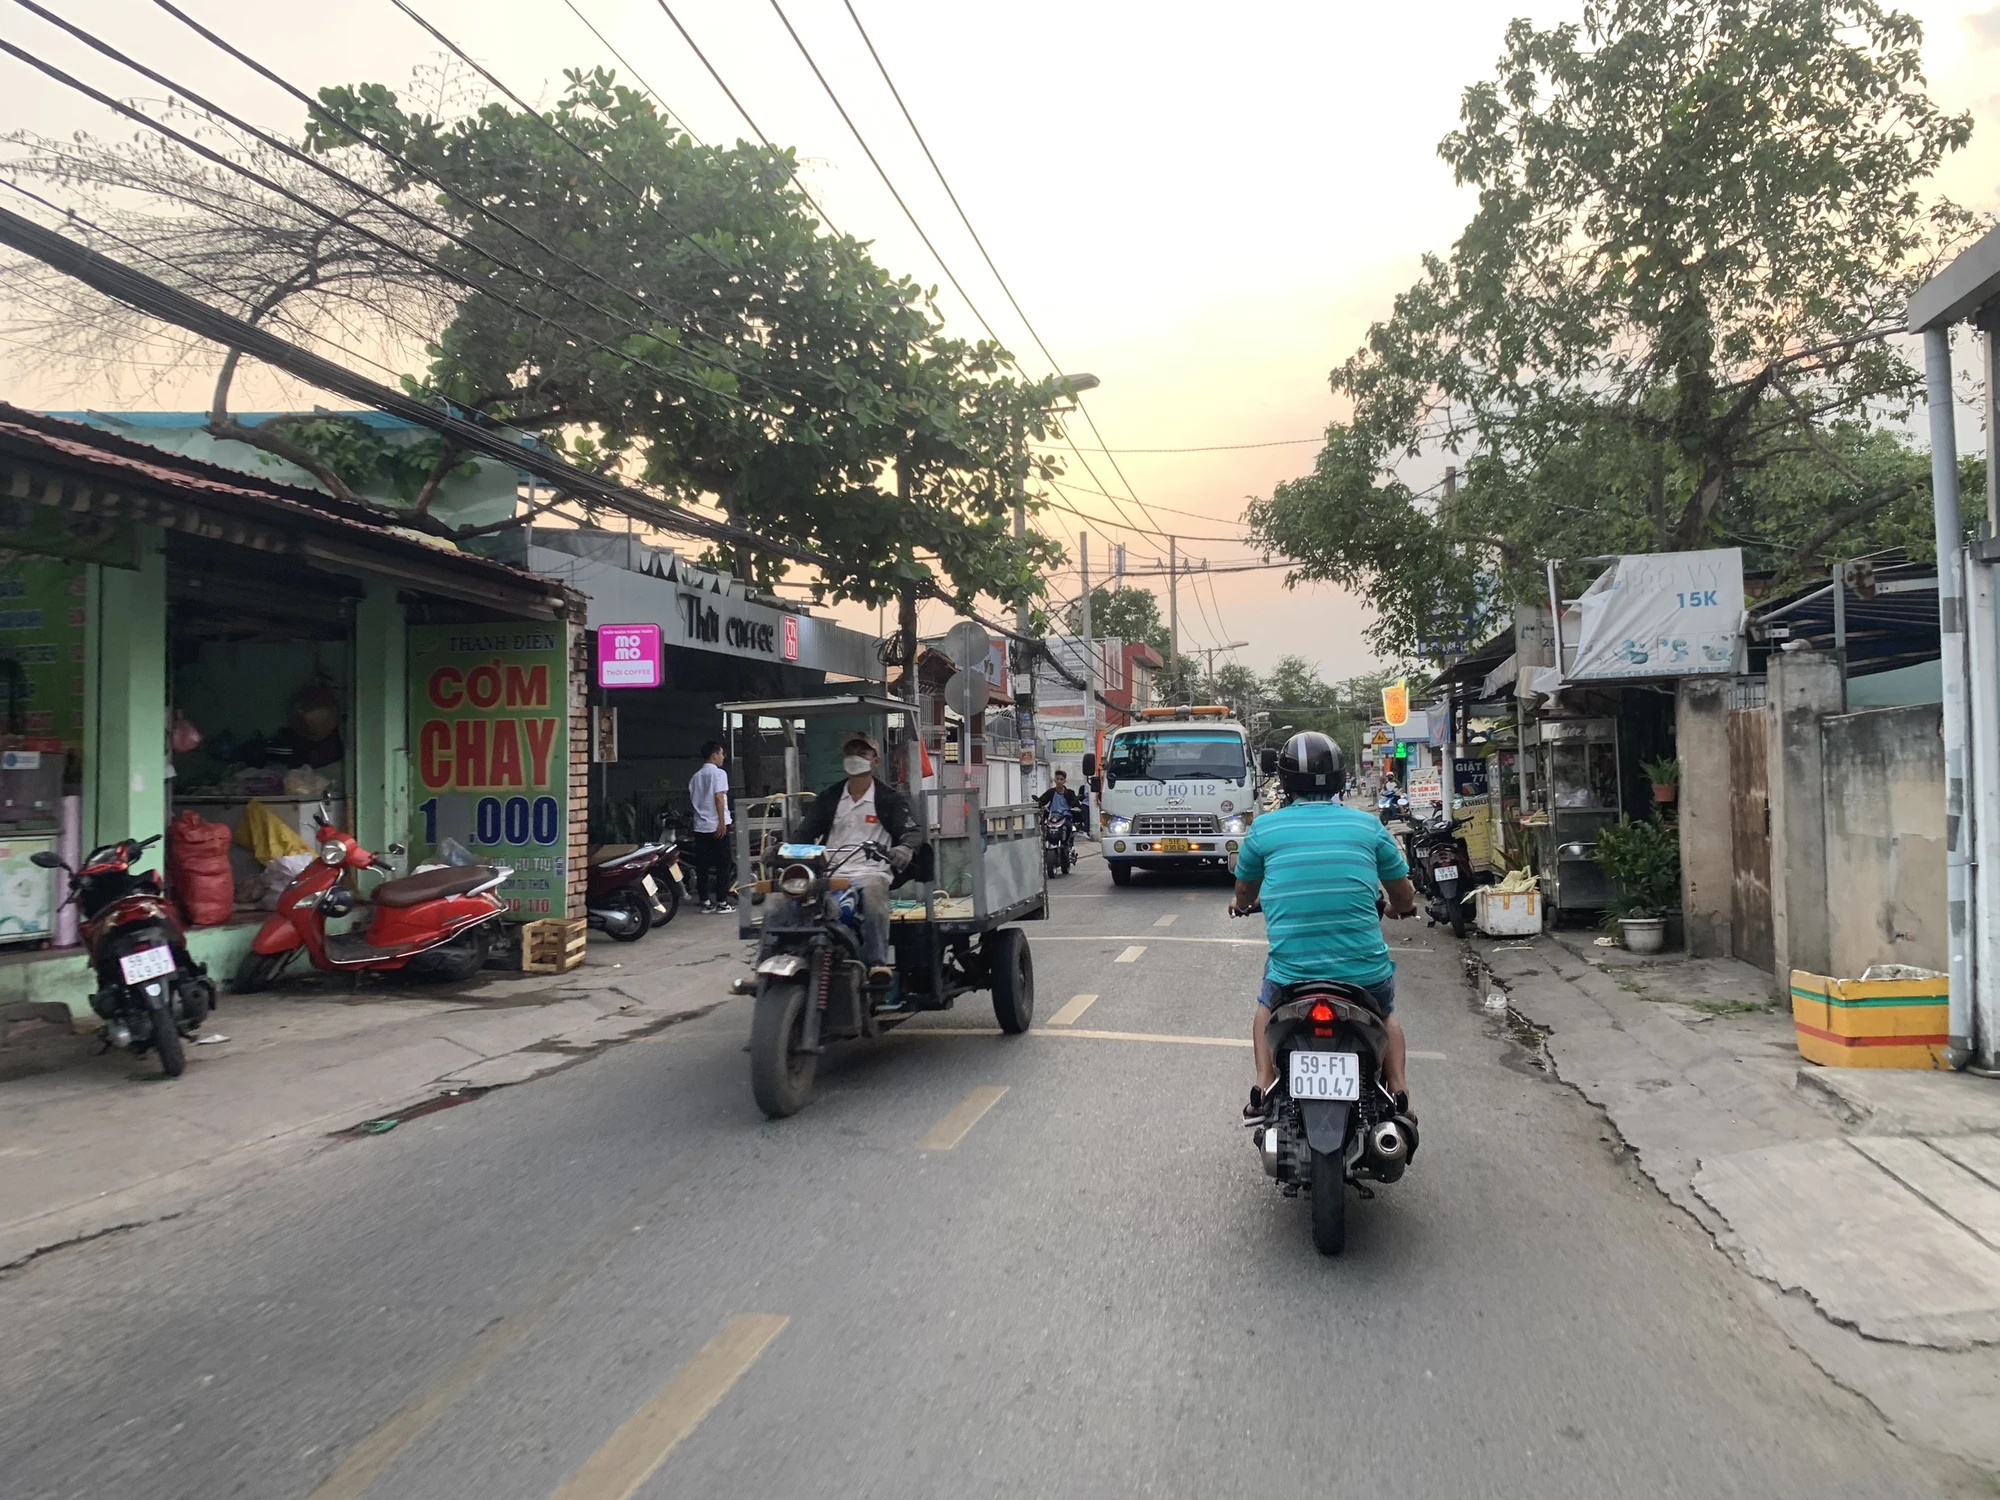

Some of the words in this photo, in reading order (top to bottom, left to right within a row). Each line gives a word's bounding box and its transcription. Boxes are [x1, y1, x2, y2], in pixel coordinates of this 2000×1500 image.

[1676, 590, 1718, 608] 15K
[429, 658, 549, 709] CƠM
[420, 718, 556, 789] CHAY
[1455, 761, 1482, 774] GIẶT
[1192, 784, 1216, 796] 112
[1300, 1055, 1346, 1075] 59-F1
[1294, 1076, 1354, 1097] 010.47
